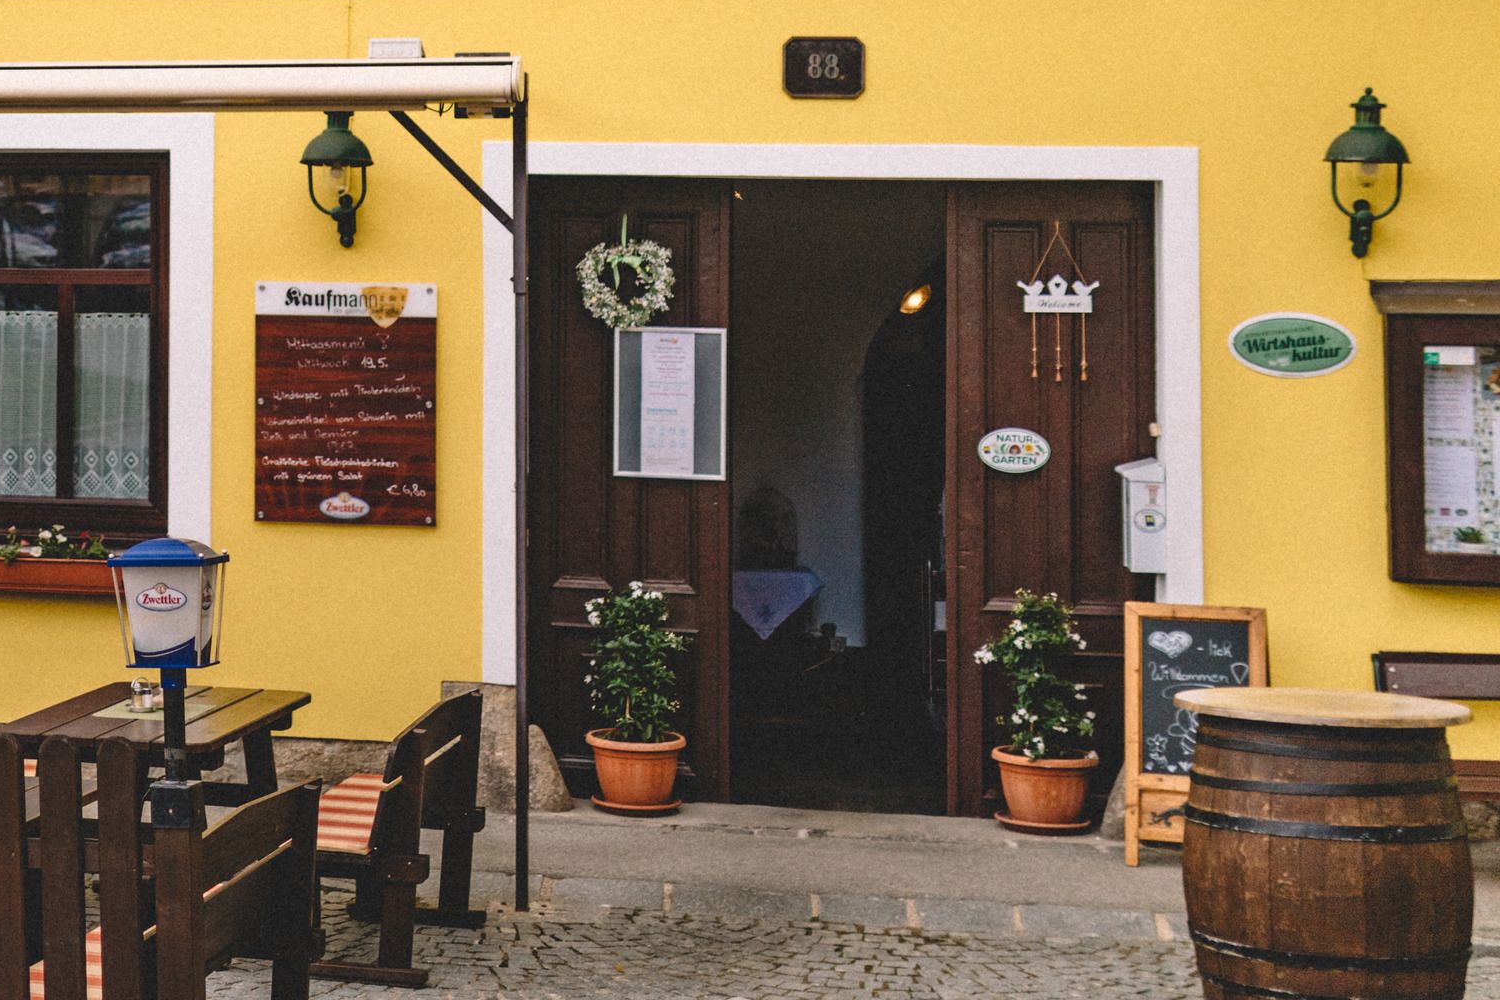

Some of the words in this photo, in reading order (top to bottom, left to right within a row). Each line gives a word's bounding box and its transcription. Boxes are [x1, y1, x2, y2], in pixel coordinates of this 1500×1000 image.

[284, 286, 378, 312] Kaufmann
[1291, 346, 1343, 363] kultur
[330, 388, 349, 398] mit
[357, 410, 397, 423] Schwein
[405, 411, 426, 421] mit
[260, 430, 283, 441] Reis
[288, 430, 307, 440] und
[996, 434, 1033, 443] NATUR
[992, 455, 1037, 465] GARTEN
[273, 471, 289, 481] mit
[337, 470, 363, 481] Salat
[325, 501, 365, 514] Zwettler
[142, 593, 182, 605] Zwettler
[1149, 661, 1230, 684] Willkommen
